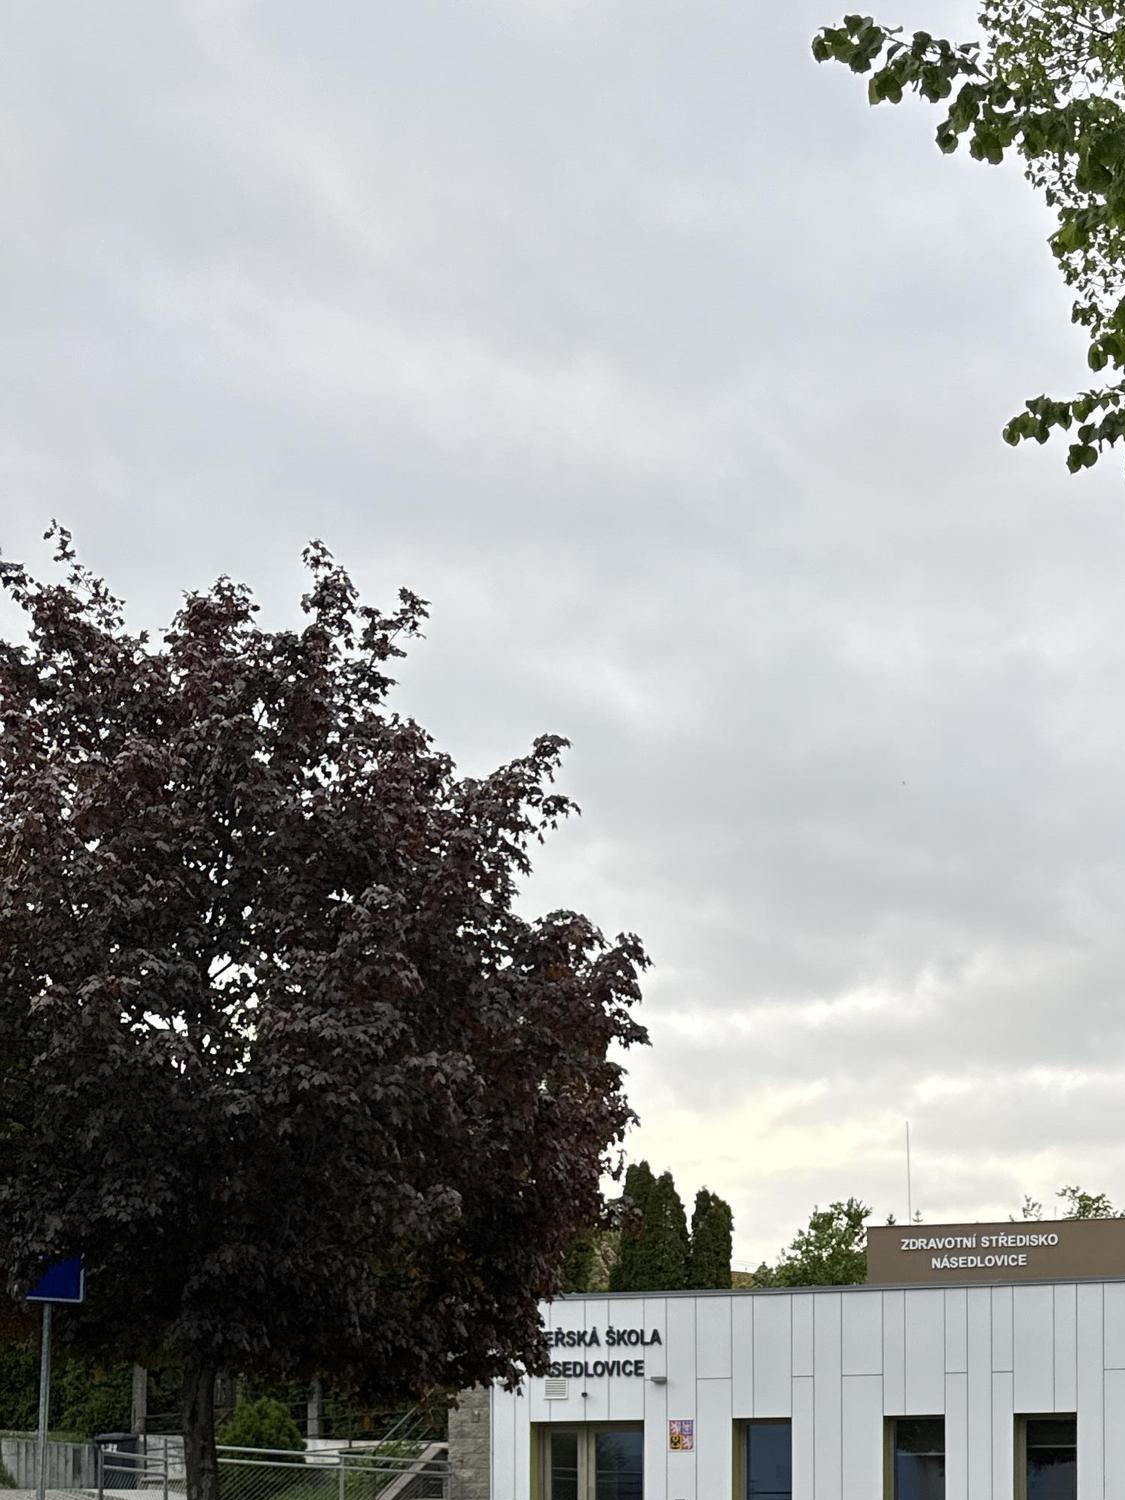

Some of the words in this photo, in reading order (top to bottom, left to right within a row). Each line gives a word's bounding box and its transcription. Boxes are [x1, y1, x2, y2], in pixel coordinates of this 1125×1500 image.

[901, 1234, 976, 1250] ZDRAVOTNÍ
[981, 1232, 1058, 1247] STŘEDISKO
[931, 1254, 1027, 1269] NÁSEDLOVICE
[544, 1326, 600, 1347] EŘSKÁ
[605, 1325, 662, 1346] ŠKOLA
[549, 1360, 645, 1378] SEDLOVICE
